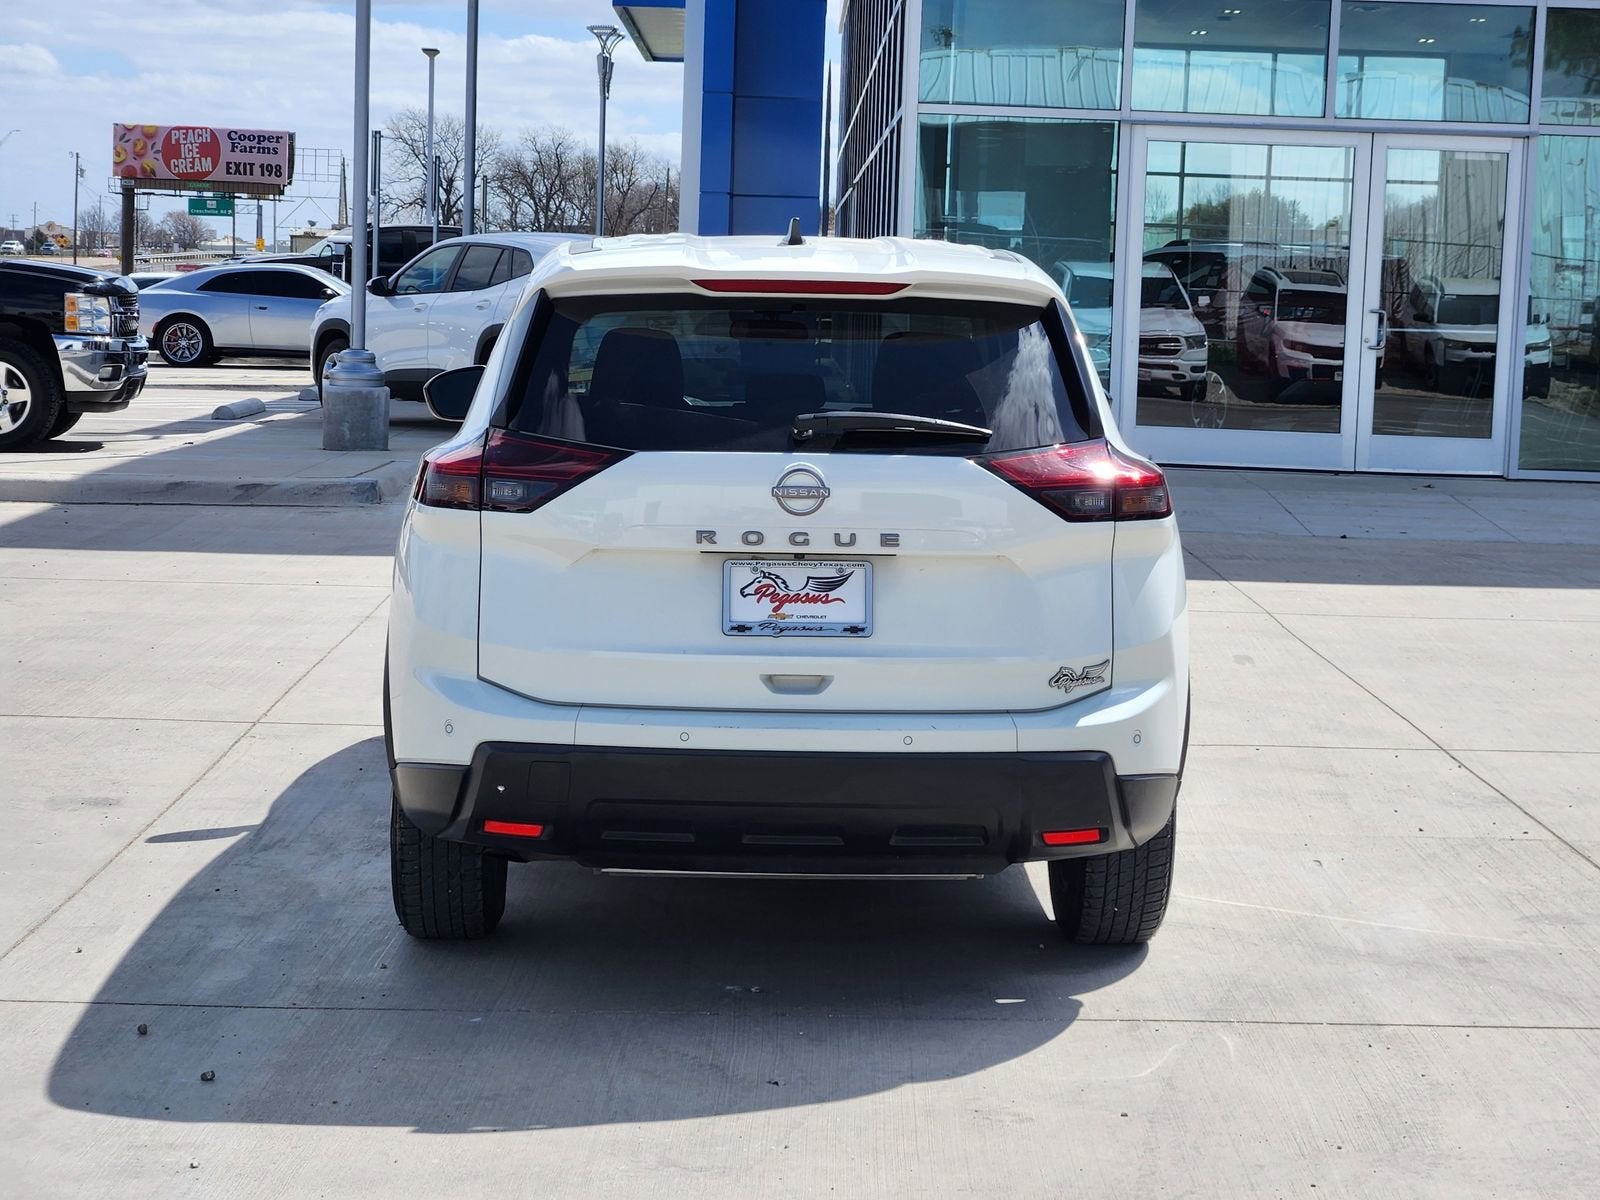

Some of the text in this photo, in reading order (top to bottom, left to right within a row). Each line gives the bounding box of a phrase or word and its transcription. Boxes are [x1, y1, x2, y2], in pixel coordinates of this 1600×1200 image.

[171, 129, 211, 144] PEACH
[227, 130, 283, 147] Cooper
[180, 143, 201, 158] ICE
[230, 141, 279, 155] Farms
[170, 159, 213, 174] CREAM
[225, 161, 283, 178] EXIT 198
[773, 488, 829, 497] NISSAN
[695, 530, 900, 547] ROGUE
[730, 560, 866, 568] www.PegasusChevyTexas.com
[754, 583, 846, 613] Pegasus
[757, 622, 839, 634] Pegasus
